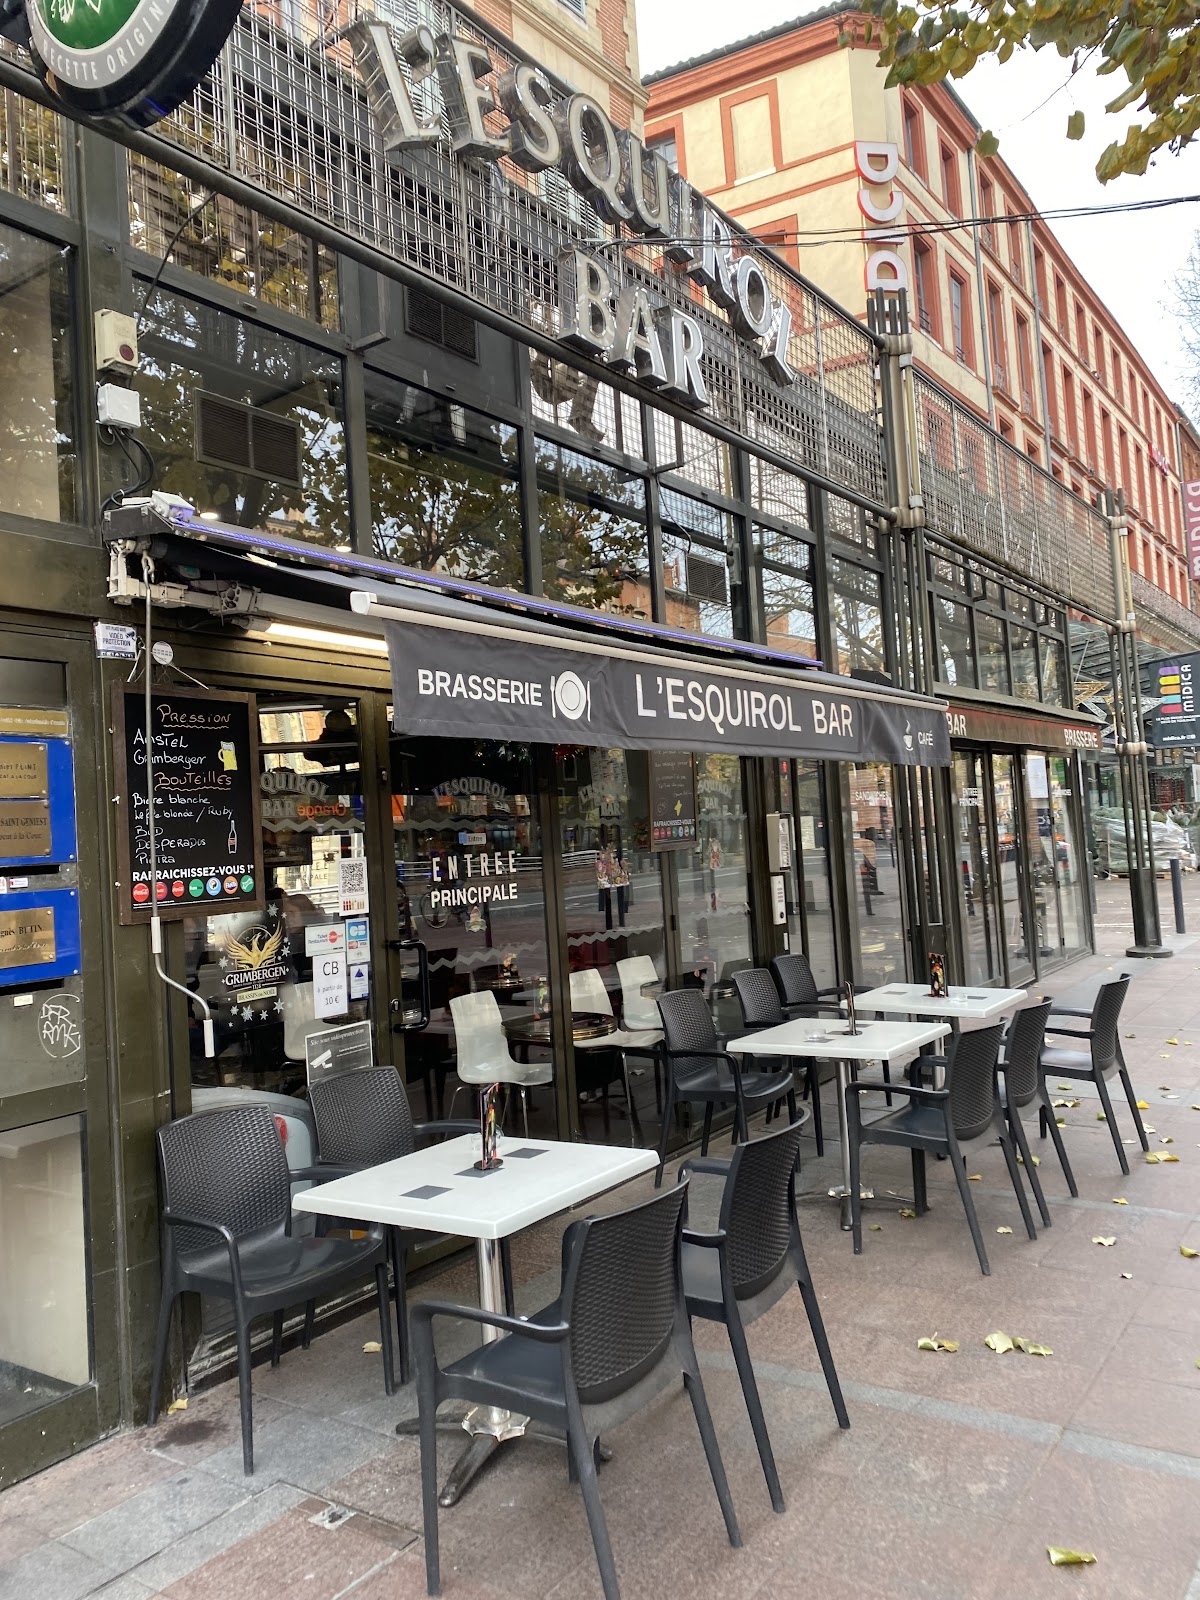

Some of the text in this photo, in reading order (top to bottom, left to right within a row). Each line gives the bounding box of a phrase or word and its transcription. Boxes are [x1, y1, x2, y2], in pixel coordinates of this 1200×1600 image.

[42, 38, 98, 81] RECETTE
[106, 0, 171, 74] ORIGIN
[558, 244, 708, 408] BAR
[417, 668, 543, 706] BRASSERIE
[635, 673, 854, 738] L'ESQUIROL BAR
[946, 712, 967, 737] BAR
[917, 730, 934, 746] CAFÉ
[1063, 728, 1099, 748] BRASSERIE
[168, 794, 210, 804] blanche
[261, 798, 298, 818] BAR
[704, 797, 720, 810] BAR
[208, 805, 234, 820] Ruby
[432, 850, 517, 882] ENTREE
[430, 883, 518, 909] PRINCIPALE
[225, 966, 286, 986] GRIMBERGEN
[322, 961, 339, 976] CB
[322, 984, 335, 995] partir
[325, 996, 334, 1006] 10
